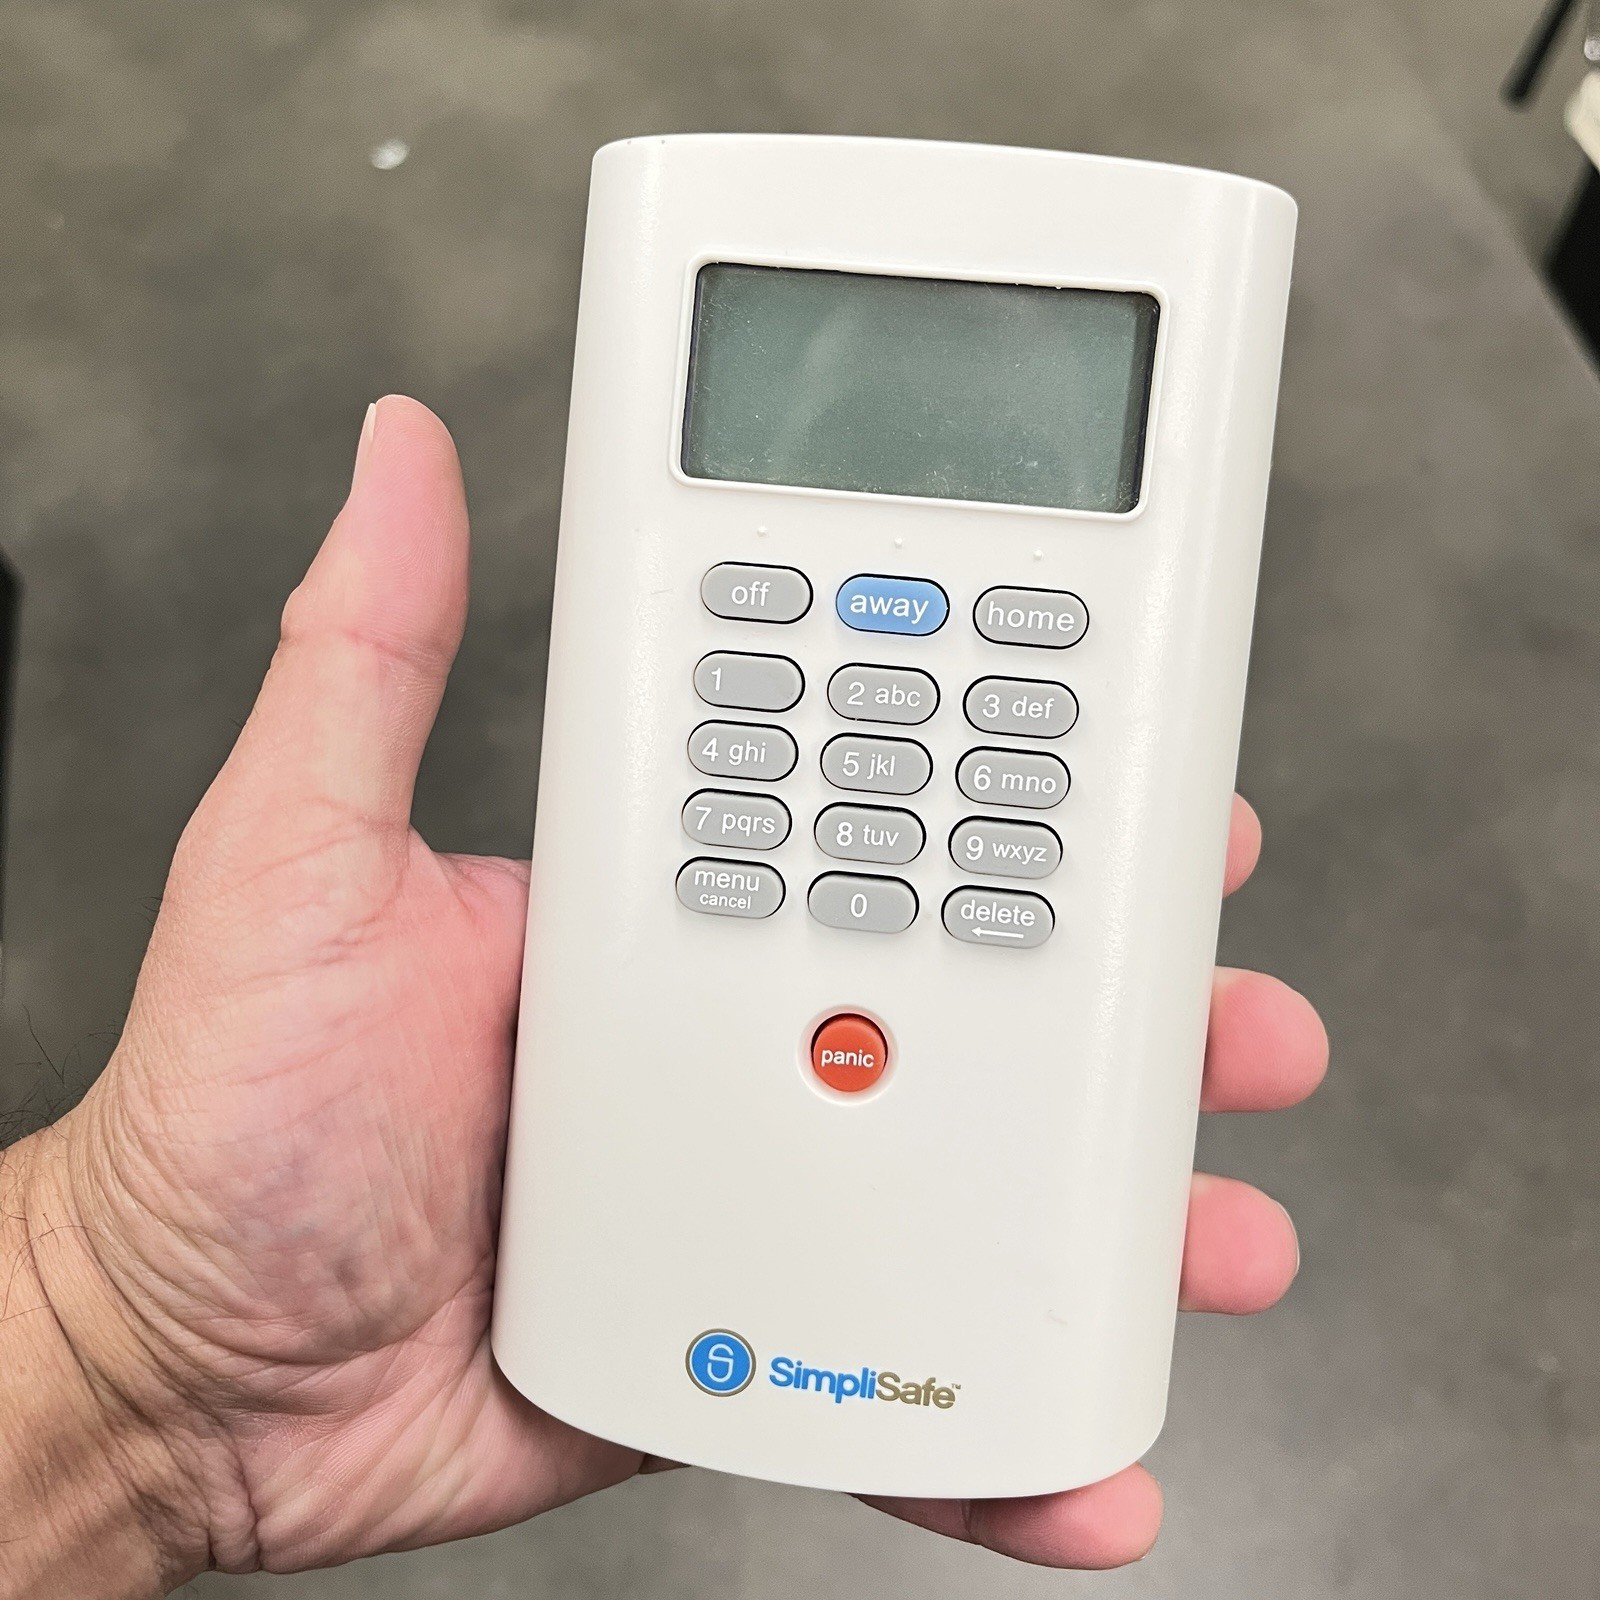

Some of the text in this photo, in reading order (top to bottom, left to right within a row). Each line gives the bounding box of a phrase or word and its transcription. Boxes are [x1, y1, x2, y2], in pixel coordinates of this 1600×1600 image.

[731, 581, 770, 607] off
[849, 592, 929, 625] away
[987, 600, 1075, 632] home
[711, 668, 722, 691] 1
[847, 682, 921, 708] 2 abc
[982, 694, 1056, 720] 3 def
[701, 738, 767, 766] 4 ghi
[842, 752, 896, 780] 5 jkl
[972, 765, 1057, 794] 6 mno
[694, 806, 776, 837] 7 pqrs
[835, 822, 900, 847] 8 tuv
[965, 836, 1048, 866] 9 wxyz
[694, 869, 760, 892] menu
[699, 892, 752, 910] cancel
[849, 893, 868, 918] 0
[960, 900, 1036, 927] delete
[820, 1048, 875, 1069] panic
